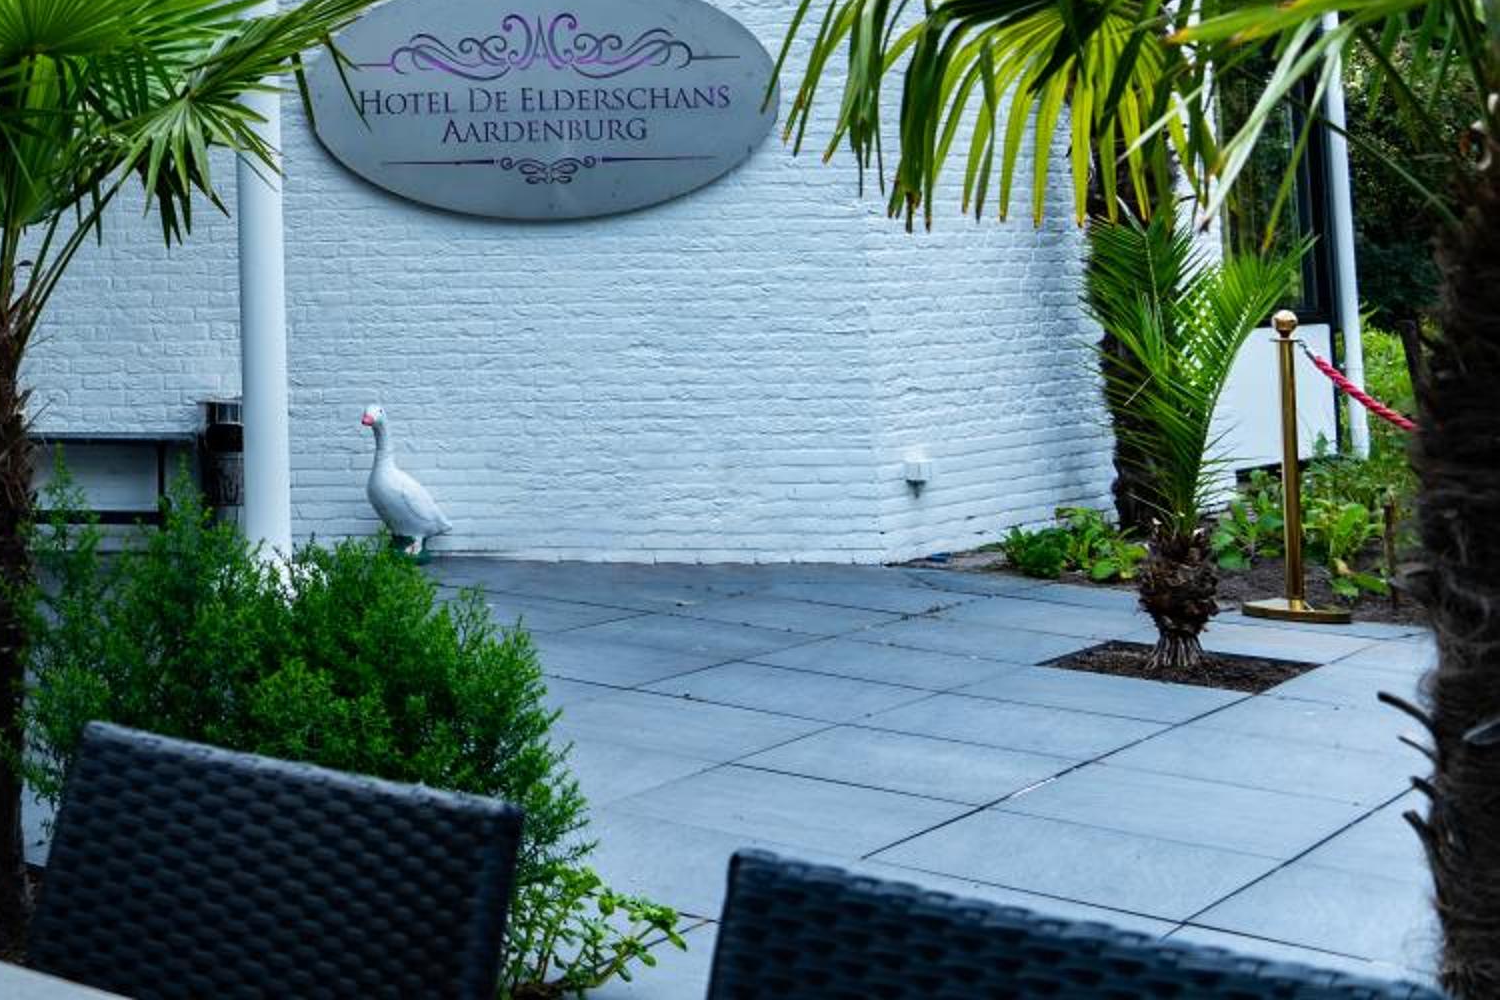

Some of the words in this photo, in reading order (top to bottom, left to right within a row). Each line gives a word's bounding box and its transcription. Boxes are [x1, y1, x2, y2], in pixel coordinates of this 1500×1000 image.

[358, 89, 457, 116] HOTEL
[468, 87, 508, 113] DE
[521, 85, 731, 112] ELDERSCHANS
[442, 117, 647, 144] AARDENBURG
